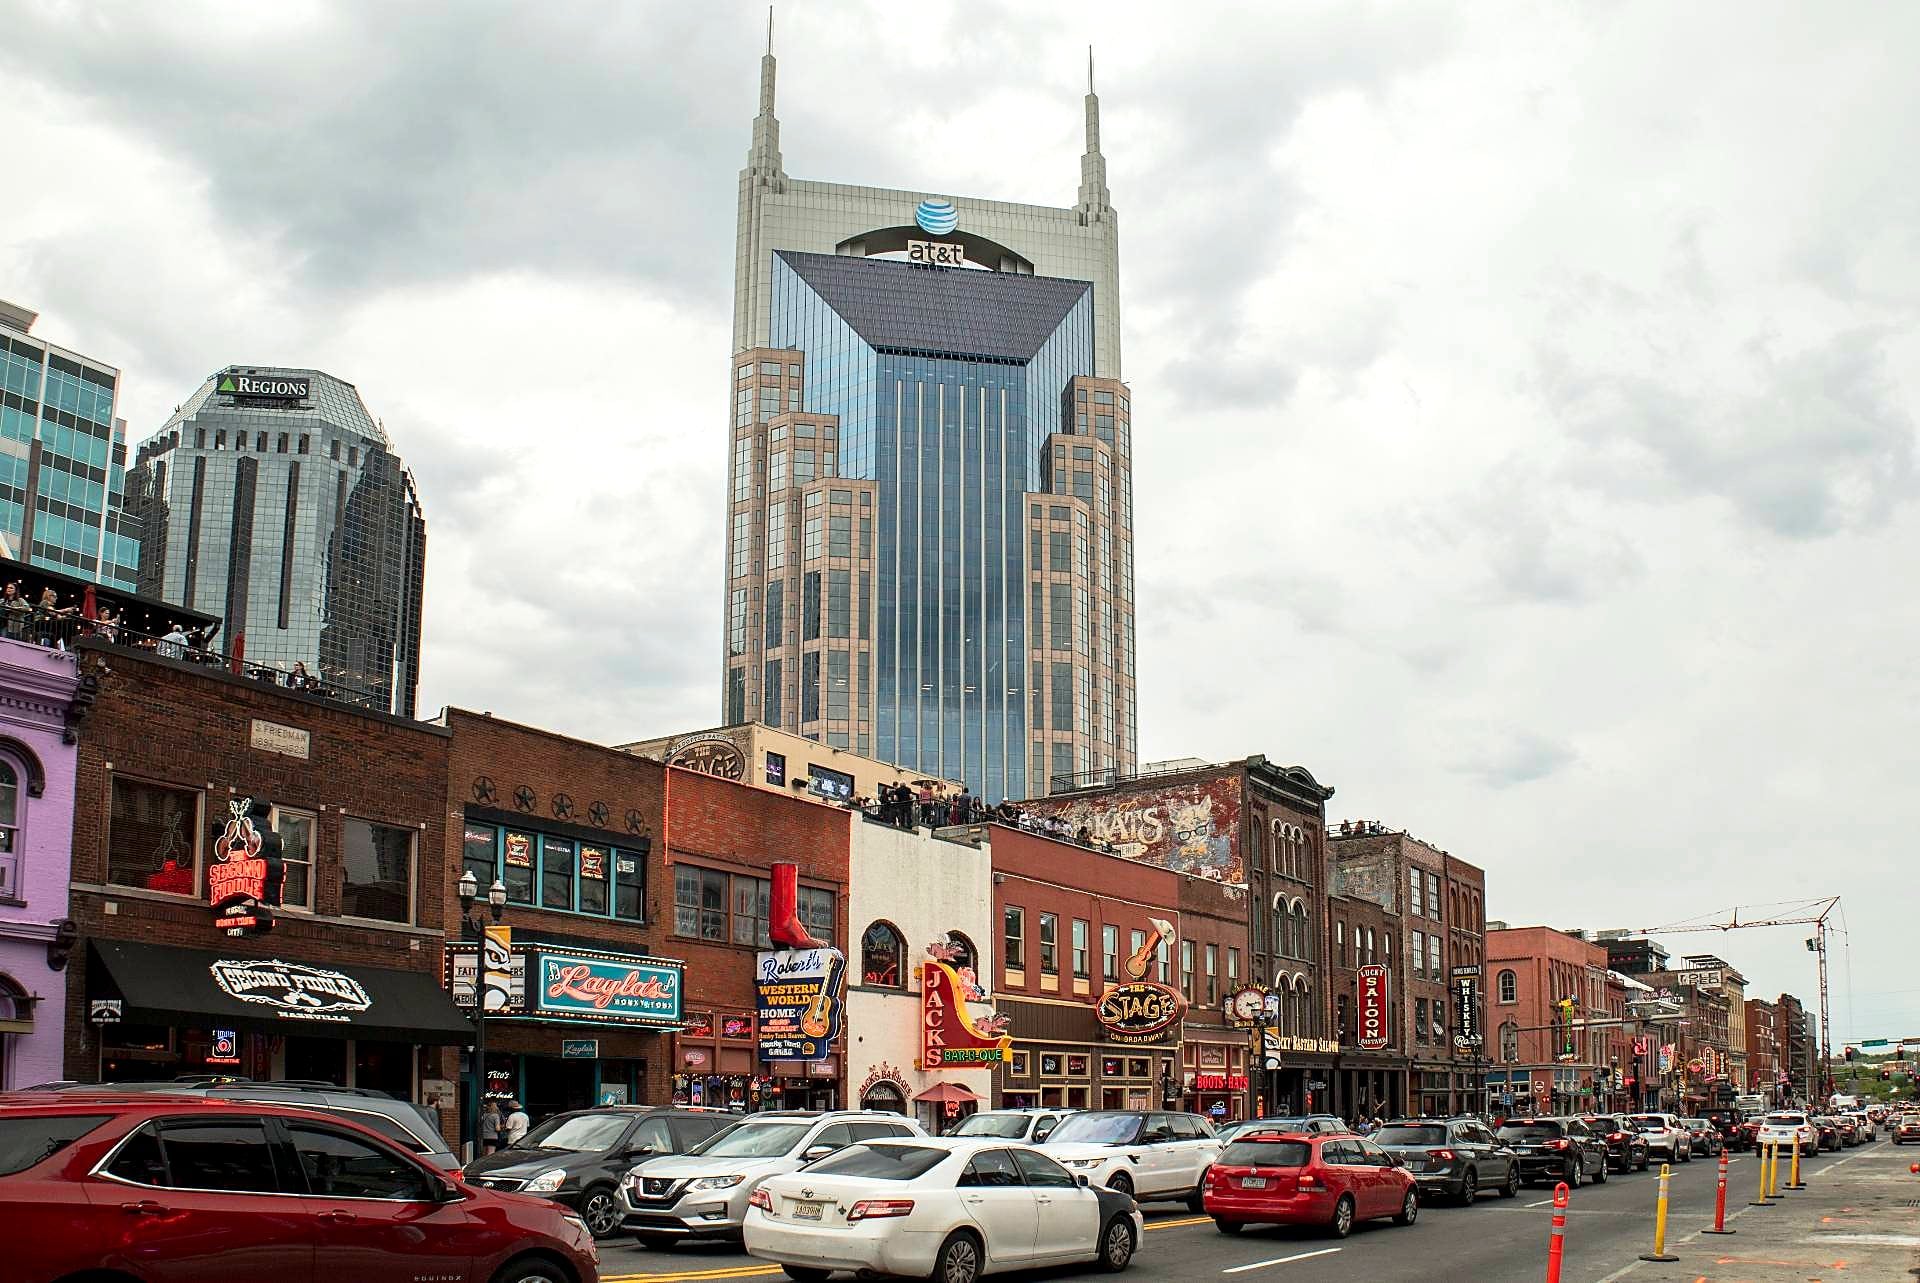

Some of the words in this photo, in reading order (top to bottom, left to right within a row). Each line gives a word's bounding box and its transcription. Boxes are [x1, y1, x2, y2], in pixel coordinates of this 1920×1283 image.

[910, 241, 962, 264] at&t
[239, 377, 307, 396] REGIONS
[695, 746, 711, 757] THE
[671, 752, 740, 777] TAGE
[210, 859, 267, 885] SECOND
[211, 877, 263, 906] FIDDLE
[762, 950, 821, 984] Robert's
[1360, 969, 1384, 977] LUCKY
[223, 968, 291, 993] SECOND
[290, 975, 356, 999] FIDDLE
[548, 965, 673, 1009] Layla's
[759, 984, 819, 995] WESTERN
[767, 995, 810, 1005] WORLD
[1102, 992, 1174, 1024] STAGE
[1365, 977, 1379, 1038] SALOON
[1461, 979, 1471, 1036] WHISKEY
[278, 1011, 351, 1022] NASHVILLE
[760, 1008, 796, 1018] HOME
[925, 971, 947, 1066] JACKS
[1111, 1033, 1120, 1041] ON
[1124, 1032, 1164, 1043] BROADWAY
[1293, 1035, 1318, 1051] BASTARD
[1318, 1037, 1339, 1053] SALOON
[1360, 1036, 1385, 1045] BASTARD
[944, 1049, 1003, 1061] BAR-B-QUE
[488, 1070, 511, 1080] Tito's
[1197, 1076, 1224, 1089] BOOTS
[1228, 1076, 1249, 1089] HATS
